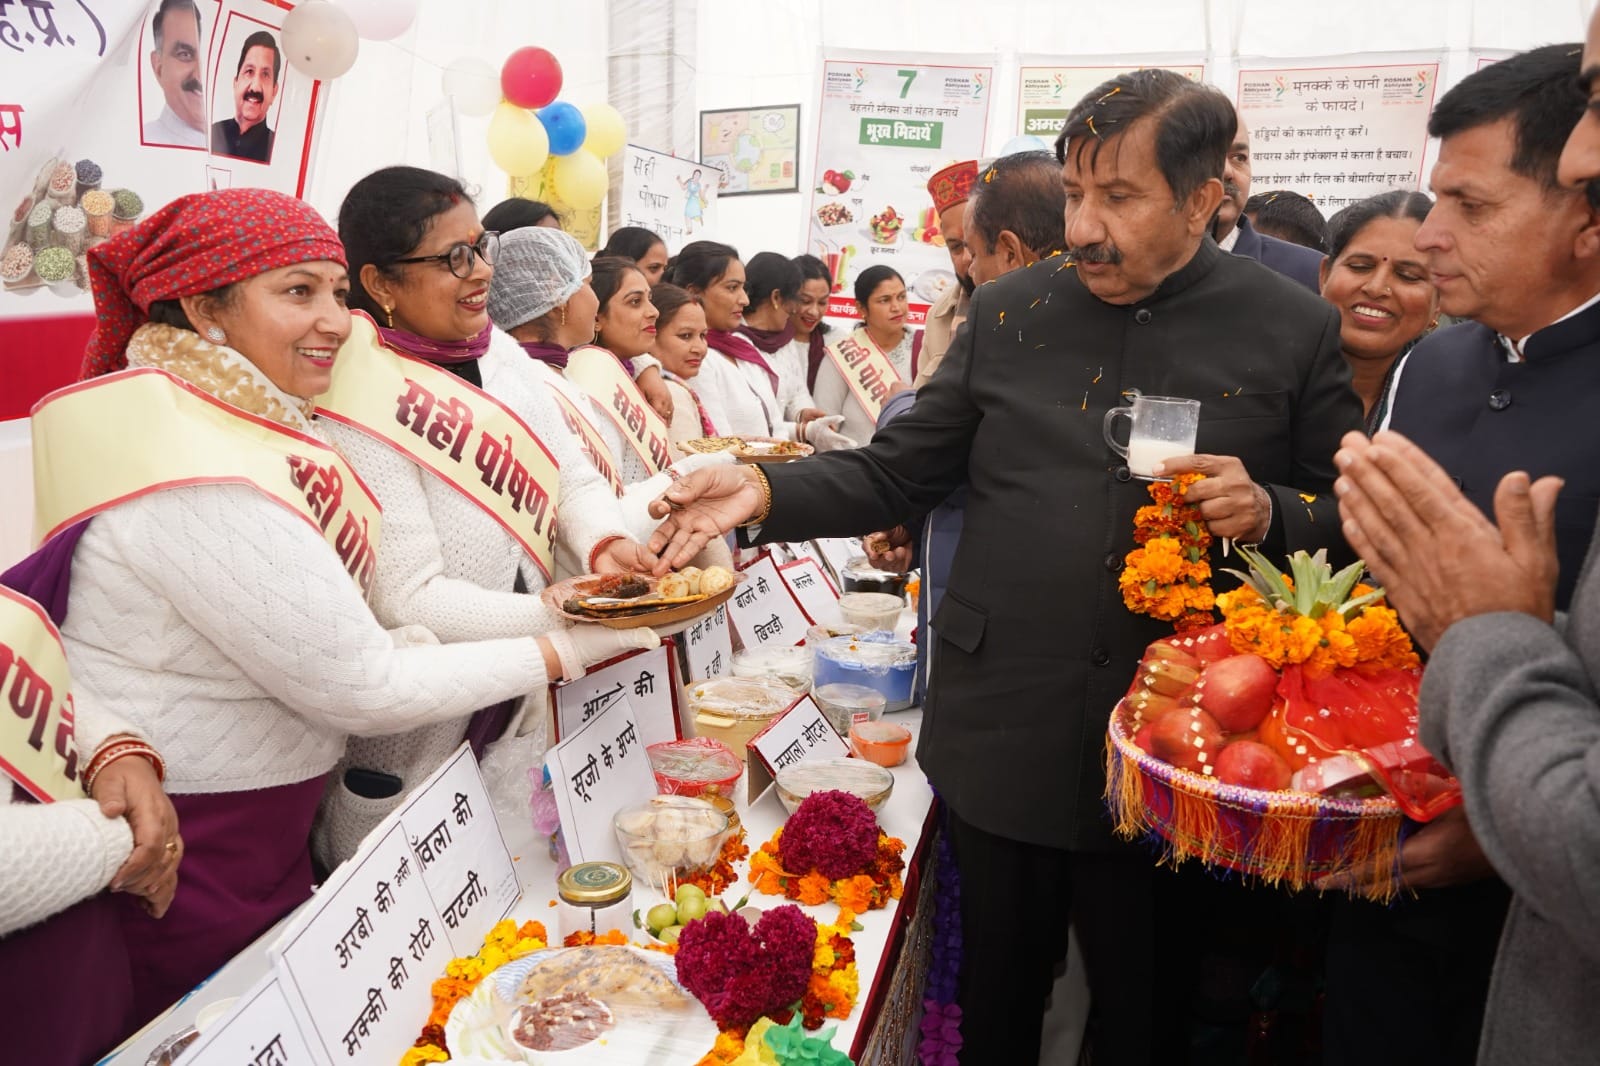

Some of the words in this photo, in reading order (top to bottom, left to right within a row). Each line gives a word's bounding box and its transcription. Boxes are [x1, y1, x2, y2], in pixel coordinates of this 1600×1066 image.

[897, 69, 918, 99] 7
[1336, 75, 1350, 91] के
[1353, 74, 1380, 90] पानी
[1305, 98, 1318, 112] के
[866, 123, 891, 143] भूख
[1282, 126, 1294, 138] की
[1334, 128, 1346, 140] दूर
[1253, 151, 1281, 161] वायरस
[1284, 148, 1299, 161] और
[1340, 147, 1348, 160] से
[1351, 150, 1374, 160] करता
[1376, 147, 1382, 161] है
[1295, 172, 1310, 184] और
[1313, 172, 1331, 184] दिल
[1333, 172, 1345, 184] की
[1387, 174, 1397, 186] दूर
[836, 336, 870, 370] सही
[859, 363, 888, 403] पोष
[613, 383, 647, 444] सही
[396, 377, 474, 464] सही
[475, 431, 550, 536] पोषण
[286, 454, 343, 534] सही
[757, 576, 771, 595] की
[633, 670, 655, 697] की
[774, 738, 806, 769] मसाला
[571, 753, 600, 803] सूजी
[601, 743, 614, 769] के
[452, 792, 473, 826] की
[334, 906, 374, 970] अरबी
[374, 881, 396, 915] की
[342, 987, 388, 1058] मक्की
[387, 956, 409, 990] की
[409, 917, 436, 963] रोटी
